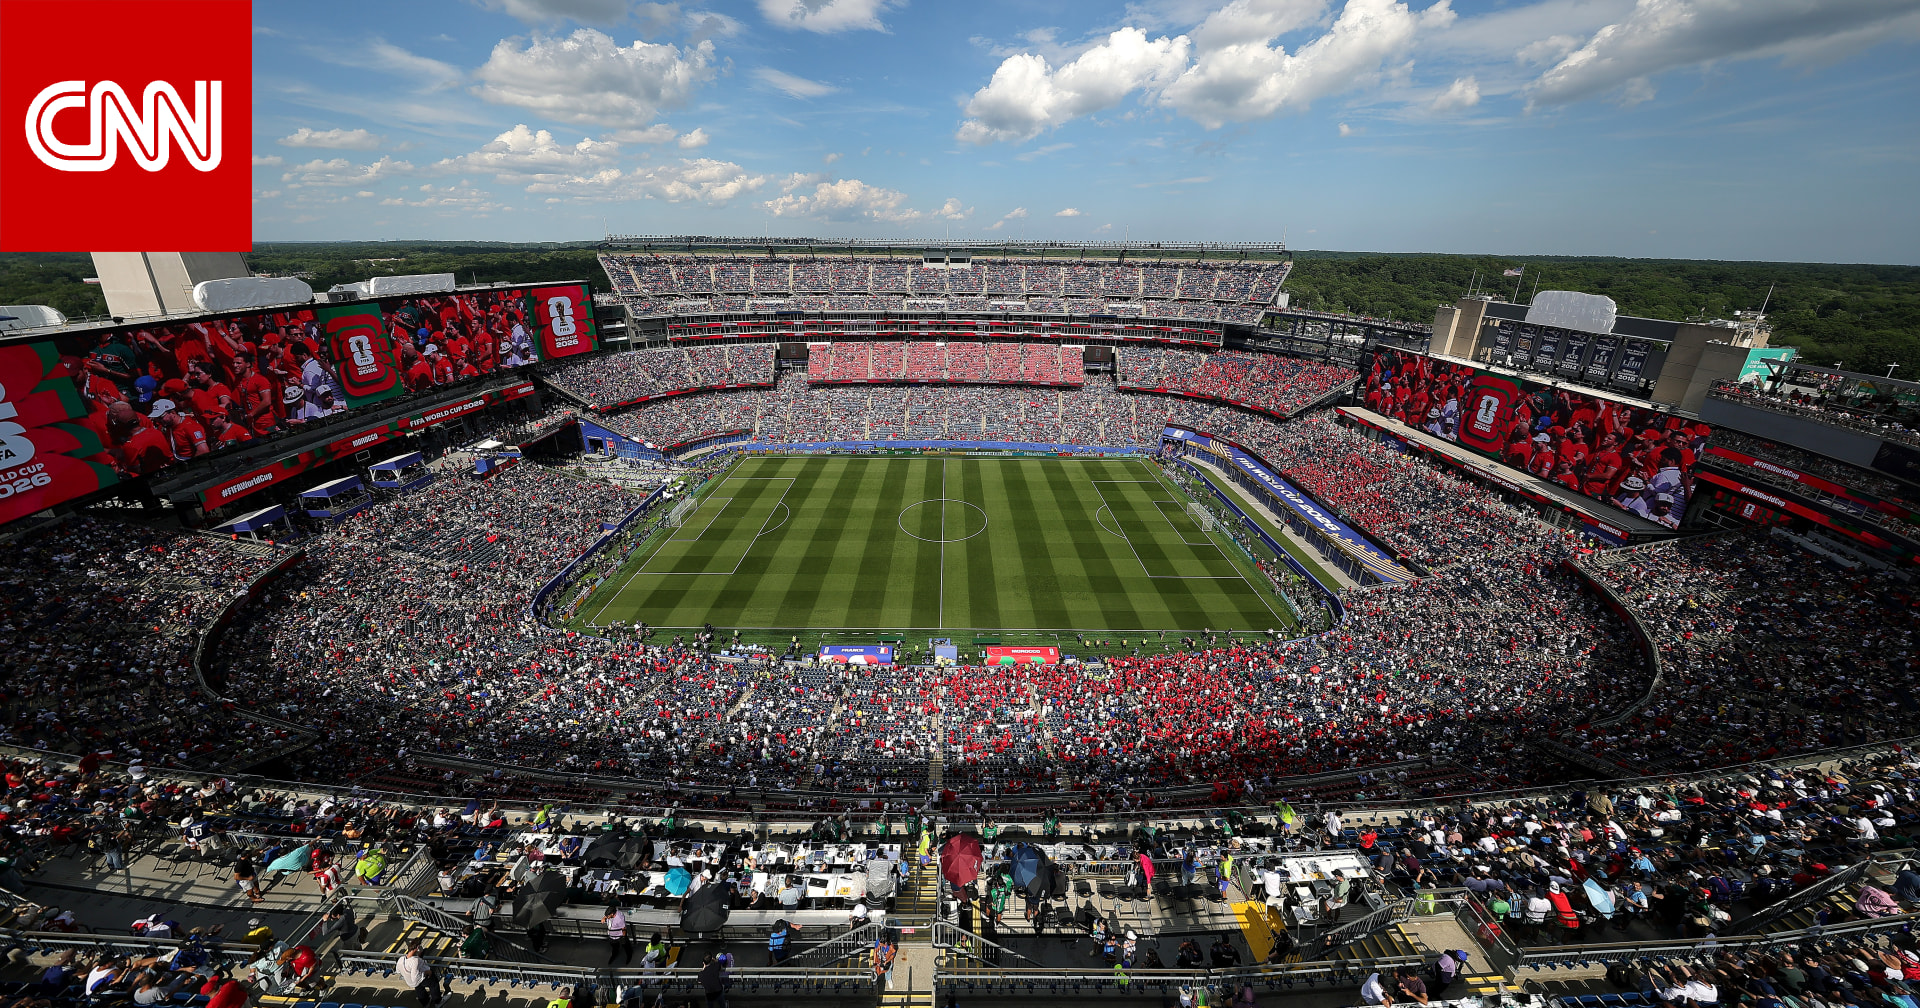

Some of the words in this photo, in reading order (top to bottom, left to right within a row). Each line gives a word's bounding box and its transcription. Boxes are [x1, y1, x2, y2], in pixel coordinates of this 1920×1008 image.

[556, 339, 579, 348] 2026
[1617, 374, 1636, 382] 2018
[409, 418, 426, 428] FIFA
[425, 410, 450, 422] WORLD
[449, 405, 463, 415] CUP
[463, 399, 485, 411] 2026
[19, 463, 45, 476] CUP
[0, 472, 52, 498] 026
[221, 472, 274, 498] #FIFAWorldCup
[1236, 457, 1256, 469] FIFA
[1252, 468, 1285, 490] WORLD
[1280, 490, 1304, 504] CUP
[1298, 503, 1341, 531] 2026
[190, 828, 203, 838] 10
